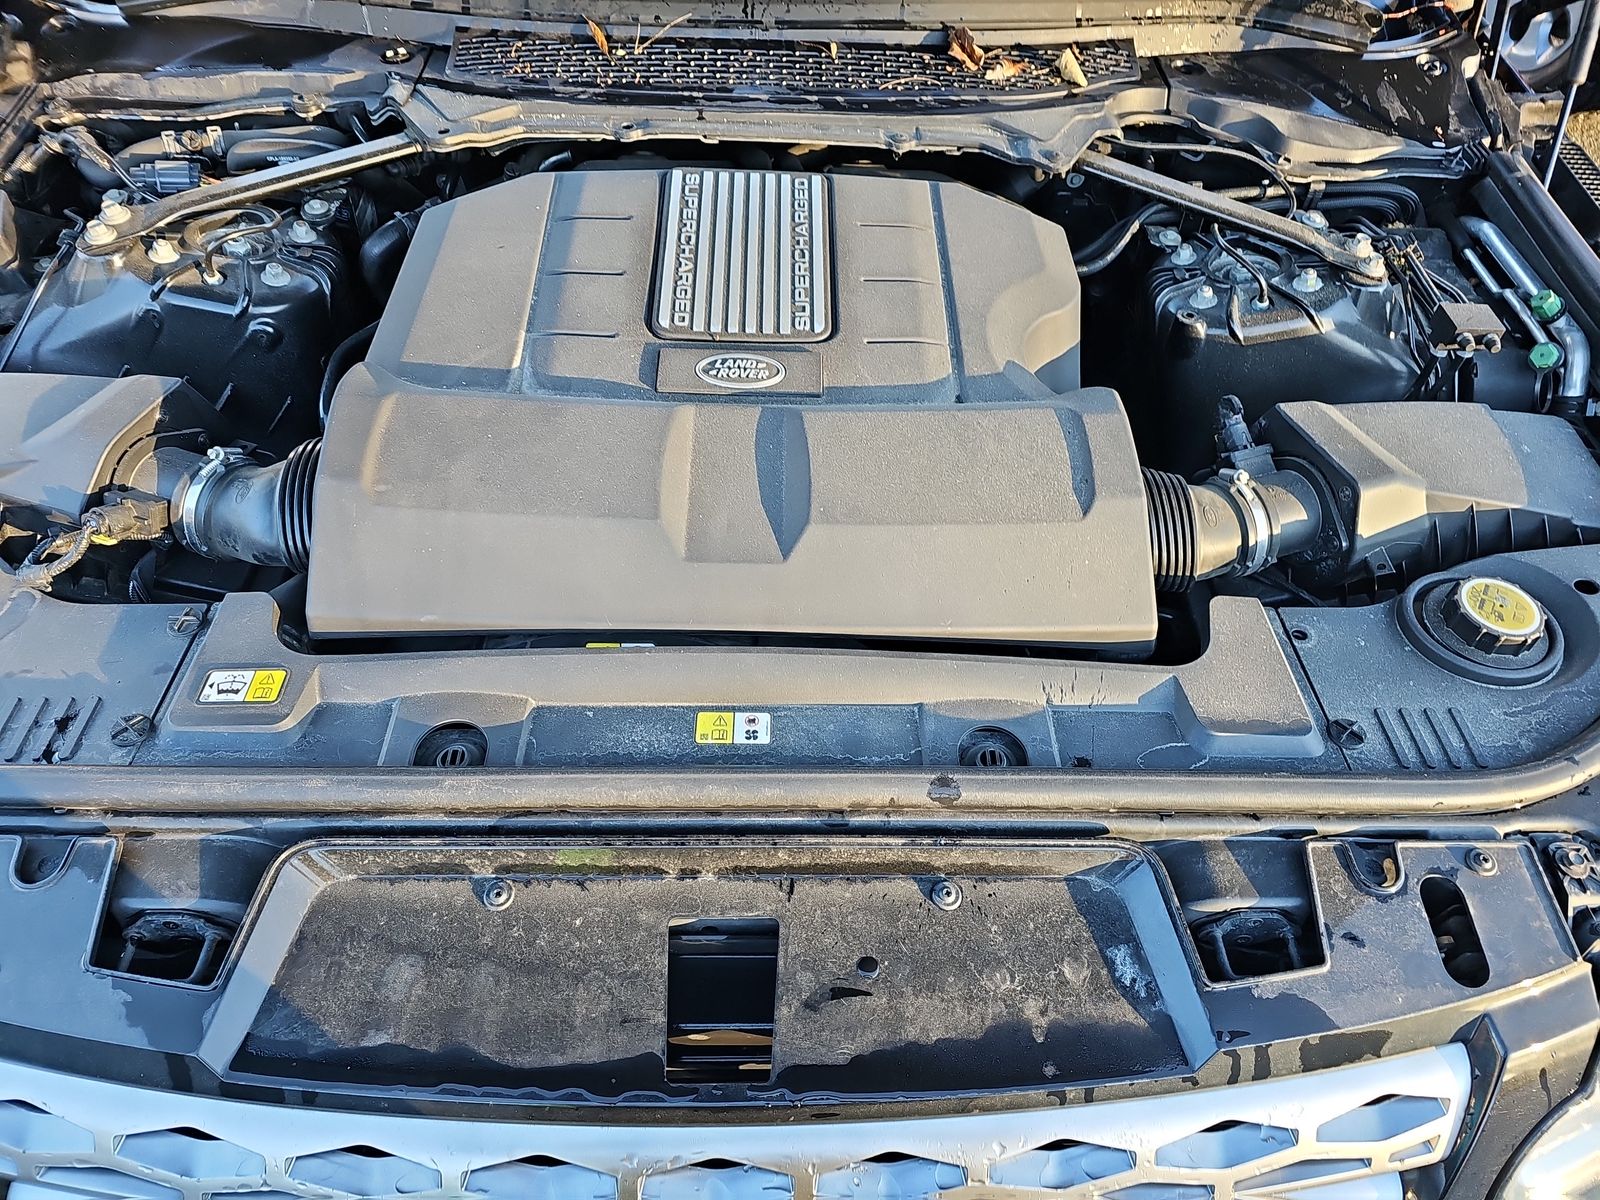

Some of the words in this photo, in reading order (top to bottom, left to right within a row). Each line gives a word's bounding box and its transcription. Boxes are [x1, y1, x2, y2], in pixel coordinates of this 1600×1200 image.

[673, 172, 700, 327] SUPERCHARGED
[794, 177, 811, 331] SUPERCHARGED
[714, 358, 757, 369] LAND
[717, 367, 770, 379] ROVER
